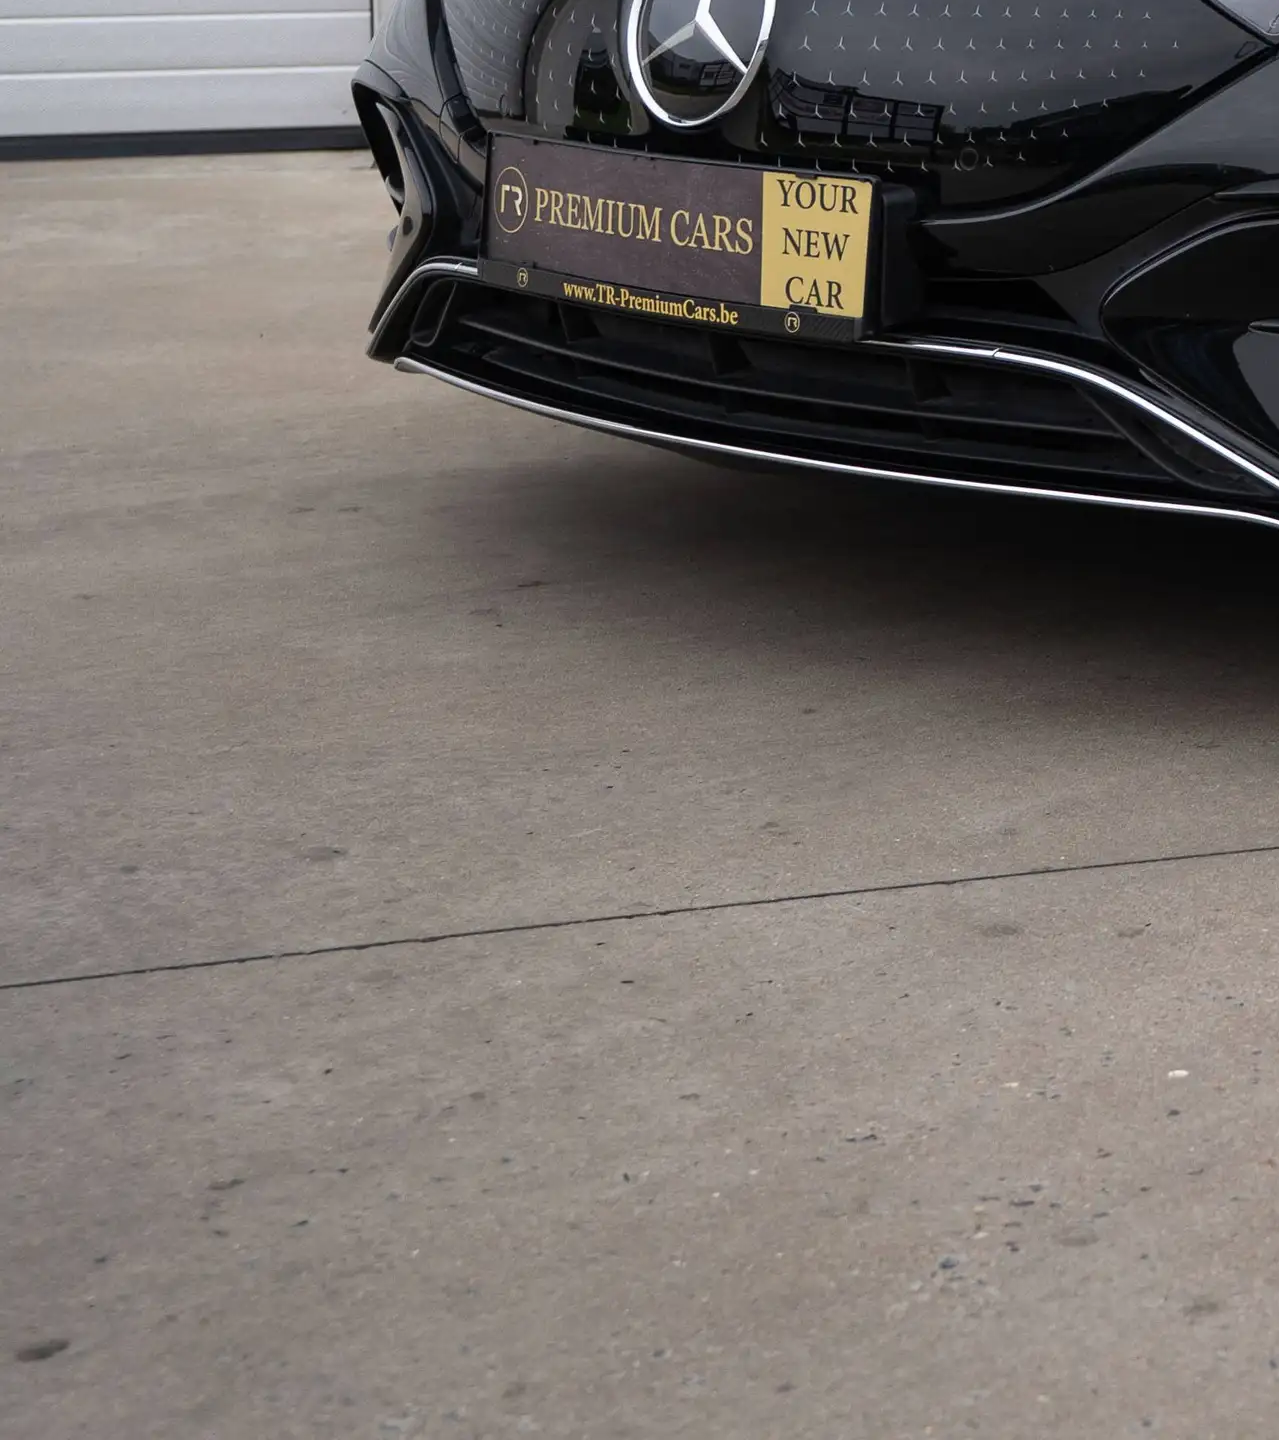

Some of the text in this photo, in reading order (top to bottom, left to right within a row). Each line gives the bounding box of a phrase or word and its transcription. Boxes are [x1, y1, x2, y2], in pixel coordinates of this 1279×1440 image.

[776, 178, 859, 215] YOUR
[534, 187, 754, 255] PREMIUM CARS
[782, 227, 850, 262] NEW
[562, 282, 739, 325] www.TR-PremiumCars.be
[785, 276, 844, 310] CAR
